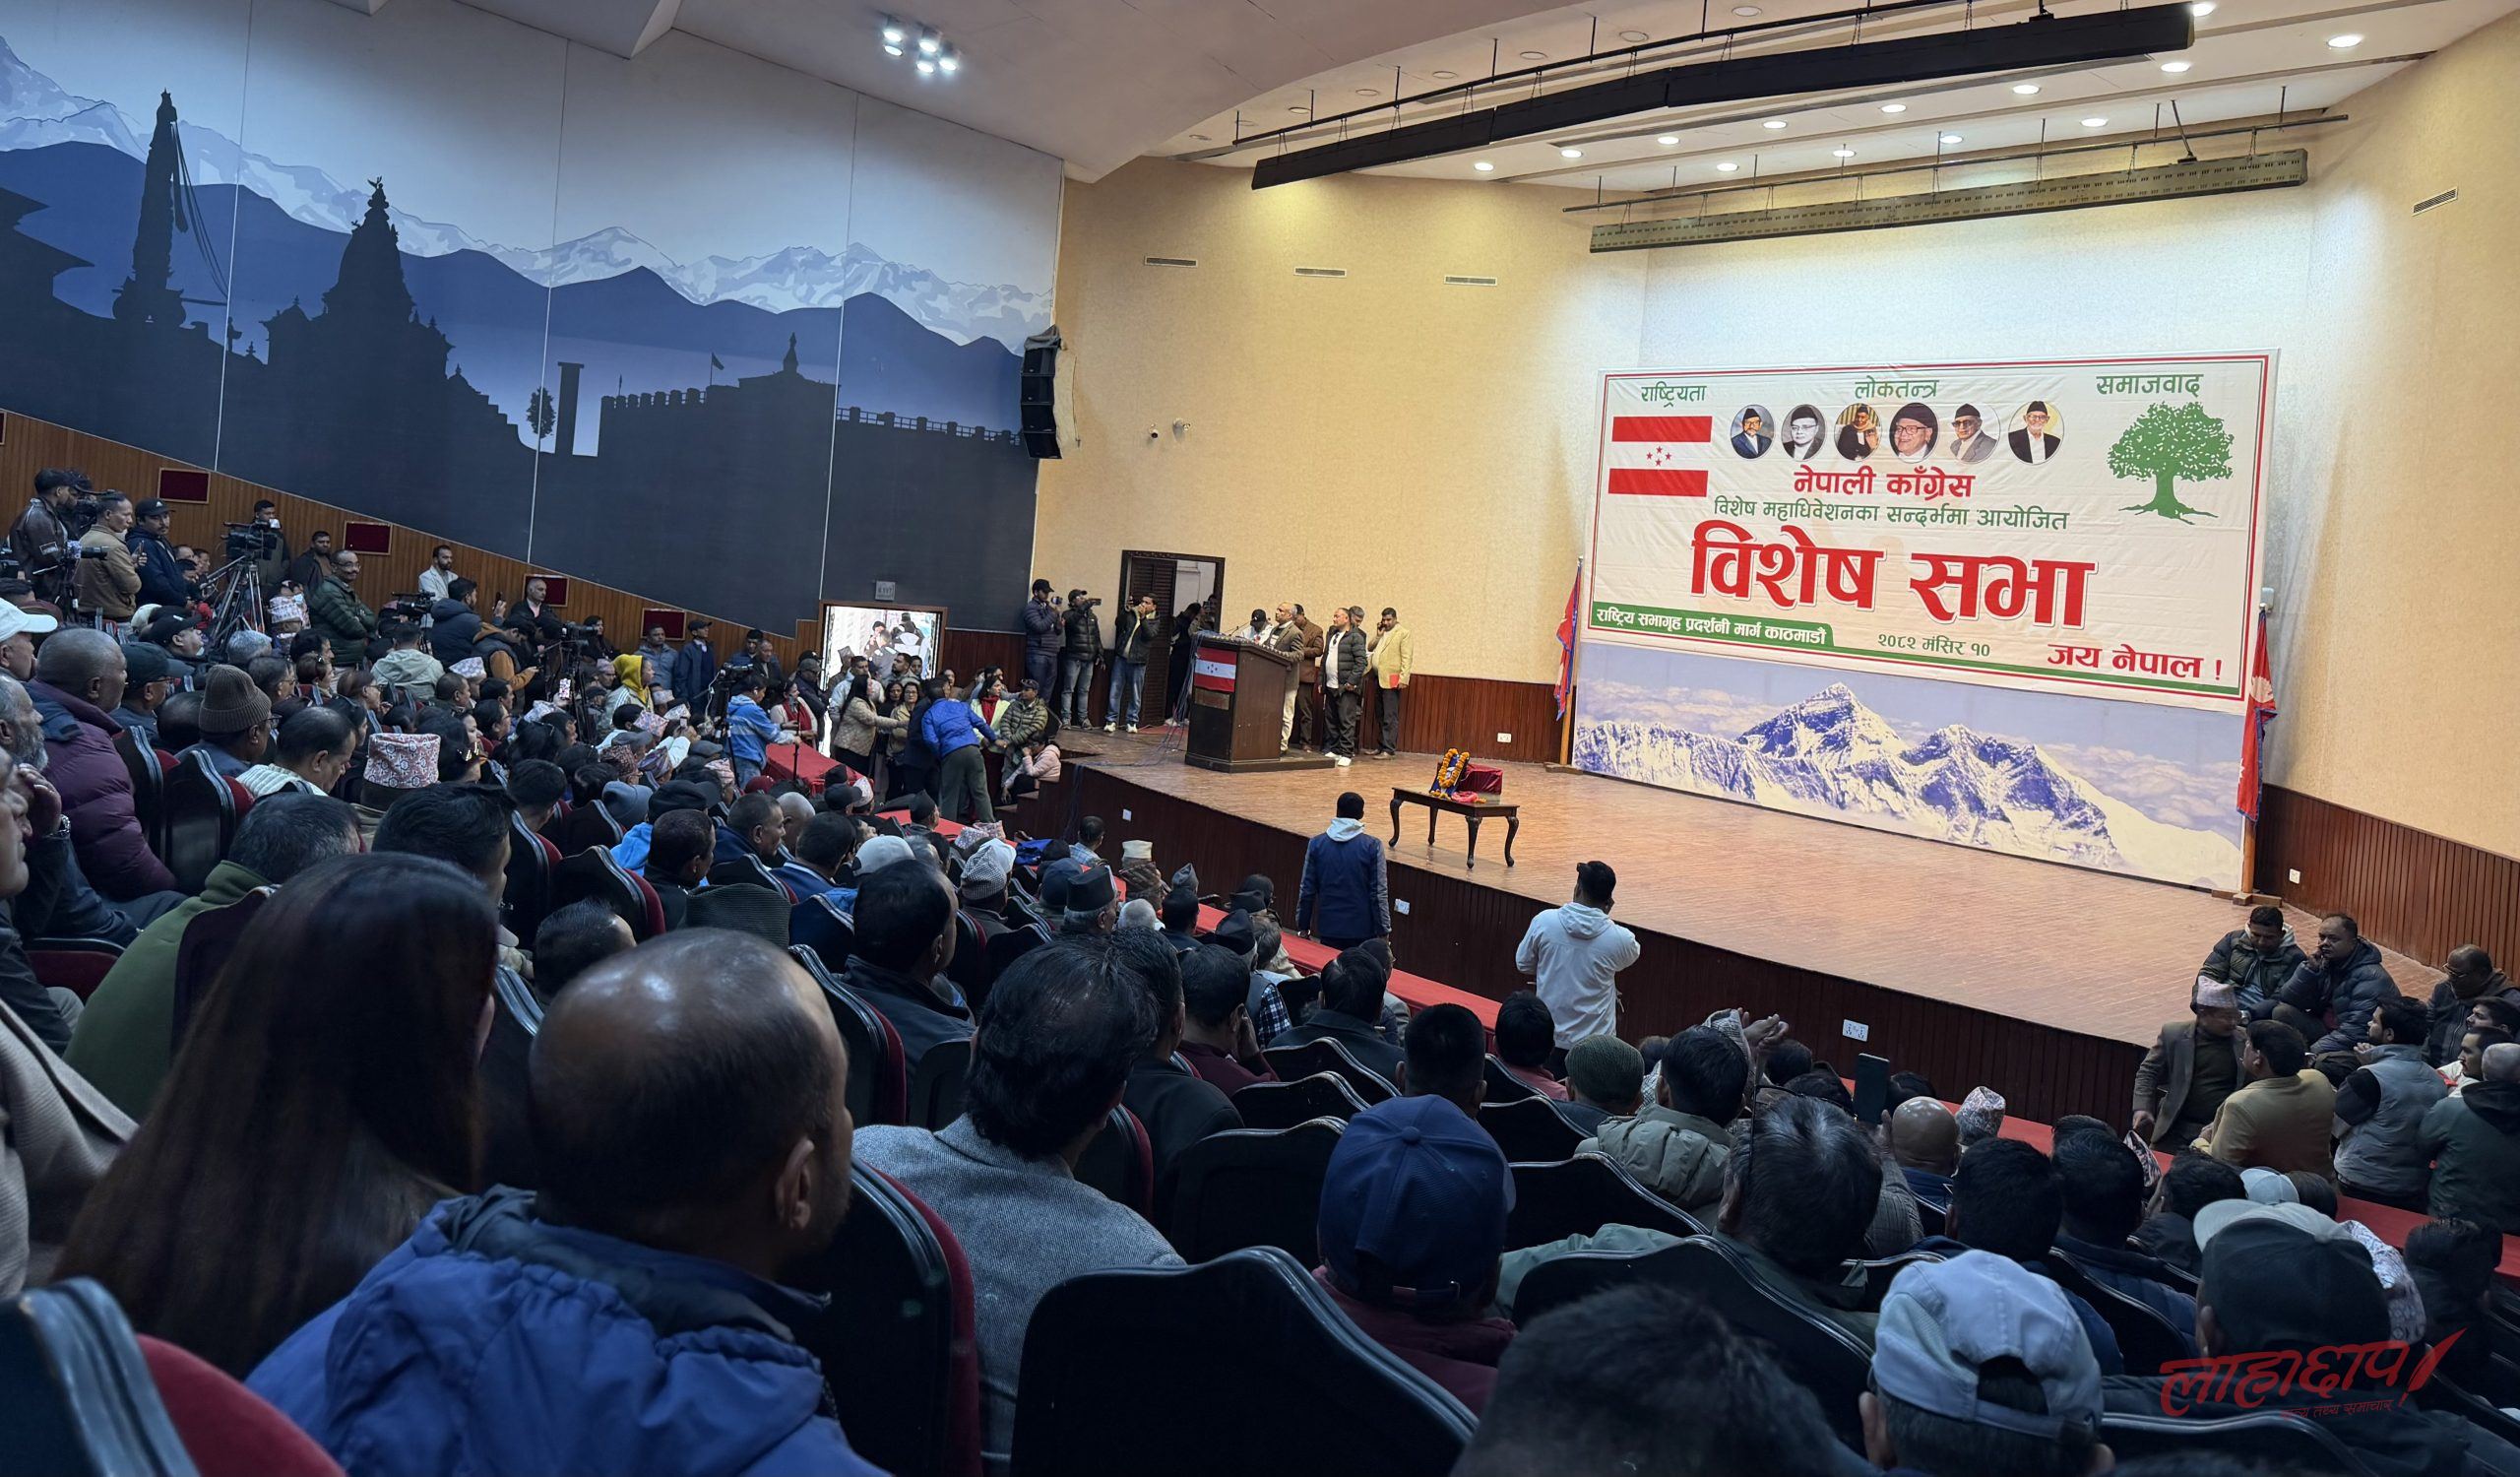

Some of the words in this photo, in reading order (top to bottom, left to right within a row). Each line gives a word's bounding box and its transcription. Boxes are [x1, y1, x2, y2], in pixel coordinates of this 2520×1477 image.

[1641, 380, 1708, 408] राष्ट्रियता
[1855, 374, 1940, 400] लोकतन्त्र
[2096, 373, 2205, 399] समाजवाद
[1794, 464, 1877, 496] नेपाली
[1886, 465, 1977, 501] काँग्रेस
[1714, 494, 1758, 517] विशेष
[1763, 497, 1881, 522] महाधिवेशनका
[1886, 502, 1970, 528] सन्दर्भमा
[1977, 504, 2071, 531] आयोजित
[1688, 518, 1887, 610] विशेष
[1908, 549, 2098, 630] सभा
[1596, 607, 1635, 626] राष्ट्रिय
[1637, 612, 1682, 632] सभागृह
[1685, 616, 1732, 635] प्रदर्शनी
[1733, 621, 1762, 638] मार्ग
[1877, 633, 1917, 650] २०८२
[1922, 634, 1967, 656] मंसिर
[1971, 642, 1991, 657] १०
[2048, 643, 2104, 669] जय
[2112, 643, 2205, 678] नेपाल
